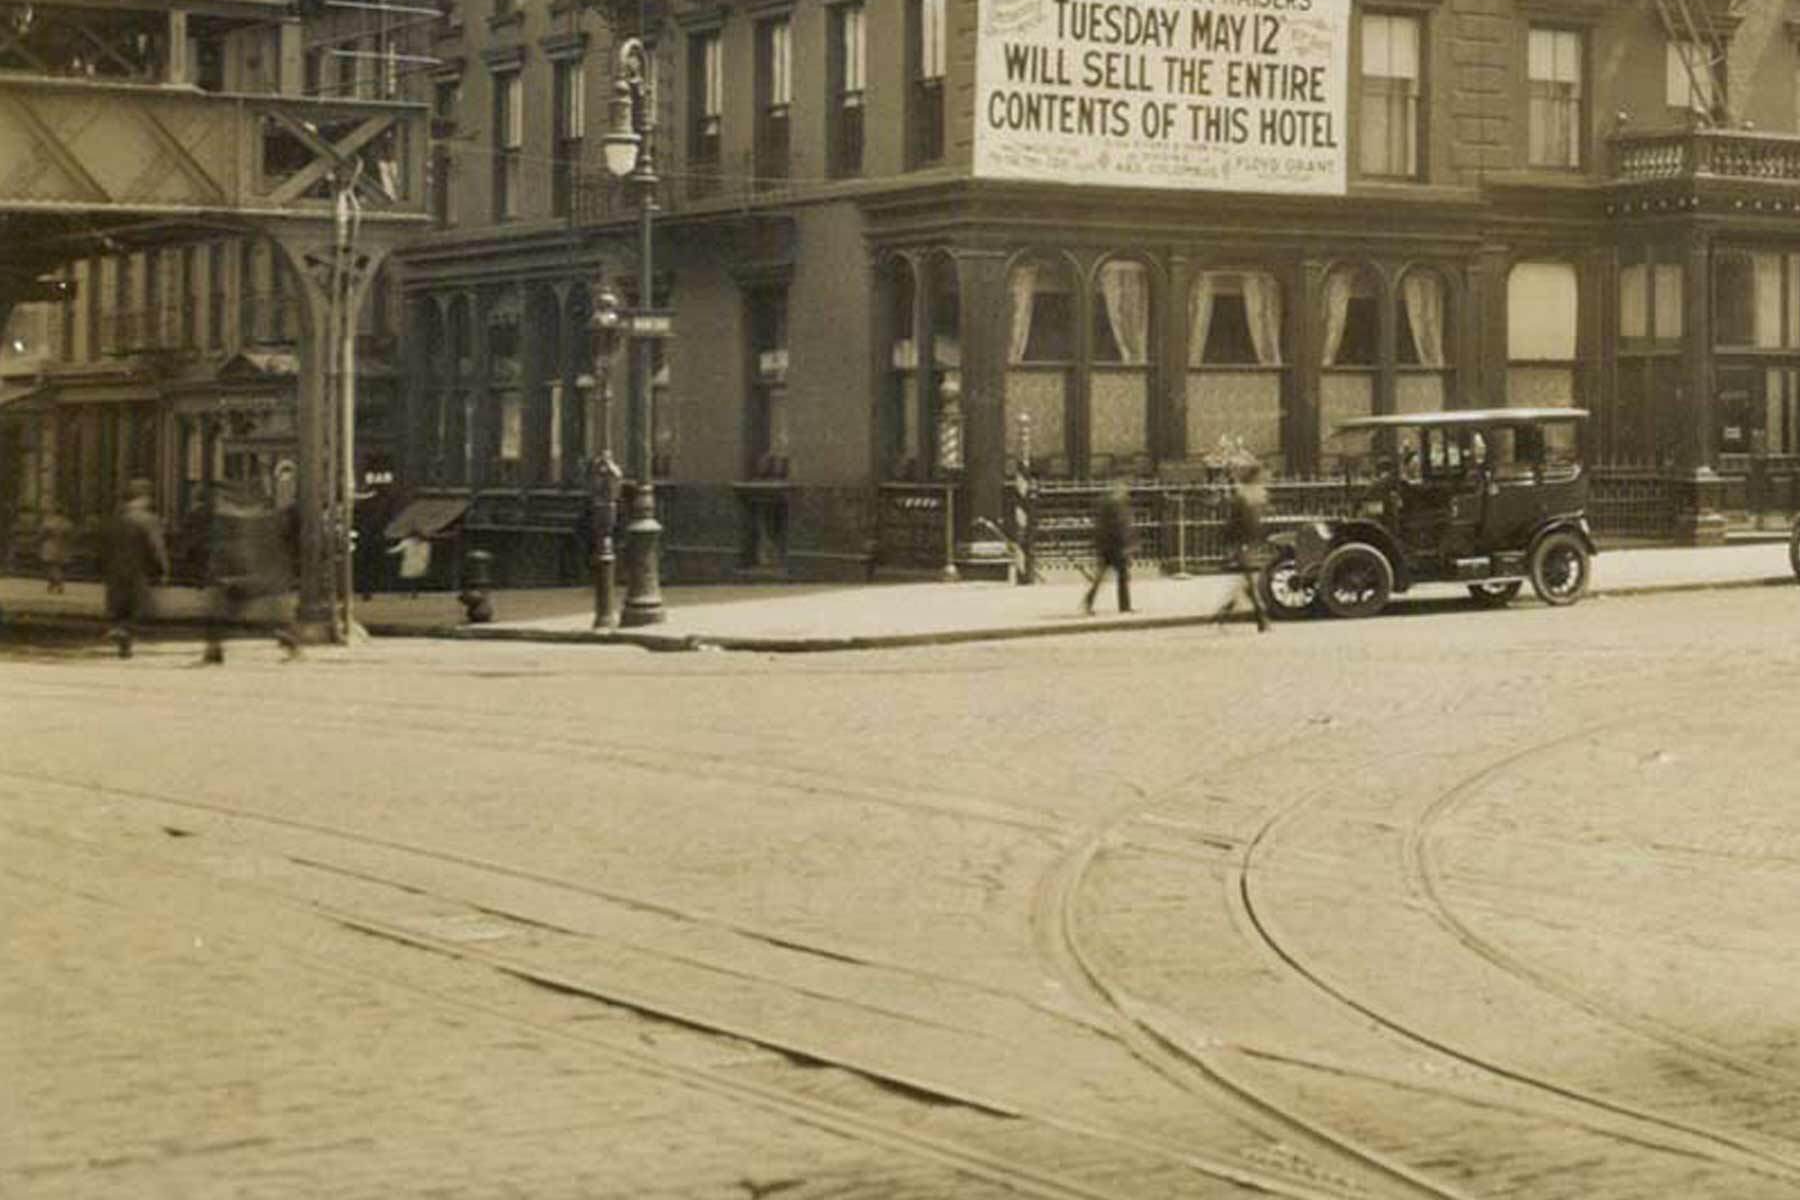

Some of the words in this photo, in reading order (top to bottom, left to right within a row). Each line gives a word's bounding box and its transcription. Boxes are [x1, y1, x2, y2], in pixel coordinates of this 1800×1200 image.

[1190, 8, 1247, 54] MAY
[1252, 13, 1281, 57] 12
[1003, 42, 1073, 87] WILL
[1081, 49, 1154, 93] SELL
[1162, 55, 1214, 97] THE
[1226, 60, 1326, 104] ENTIRE
[987, 89, 1130, 138] CONTENTS
[1141, 100, 1178, 140] OF
[1186, 104, 1249, 145] THIS
[1259, 108, 1338, 150] HOTEL
